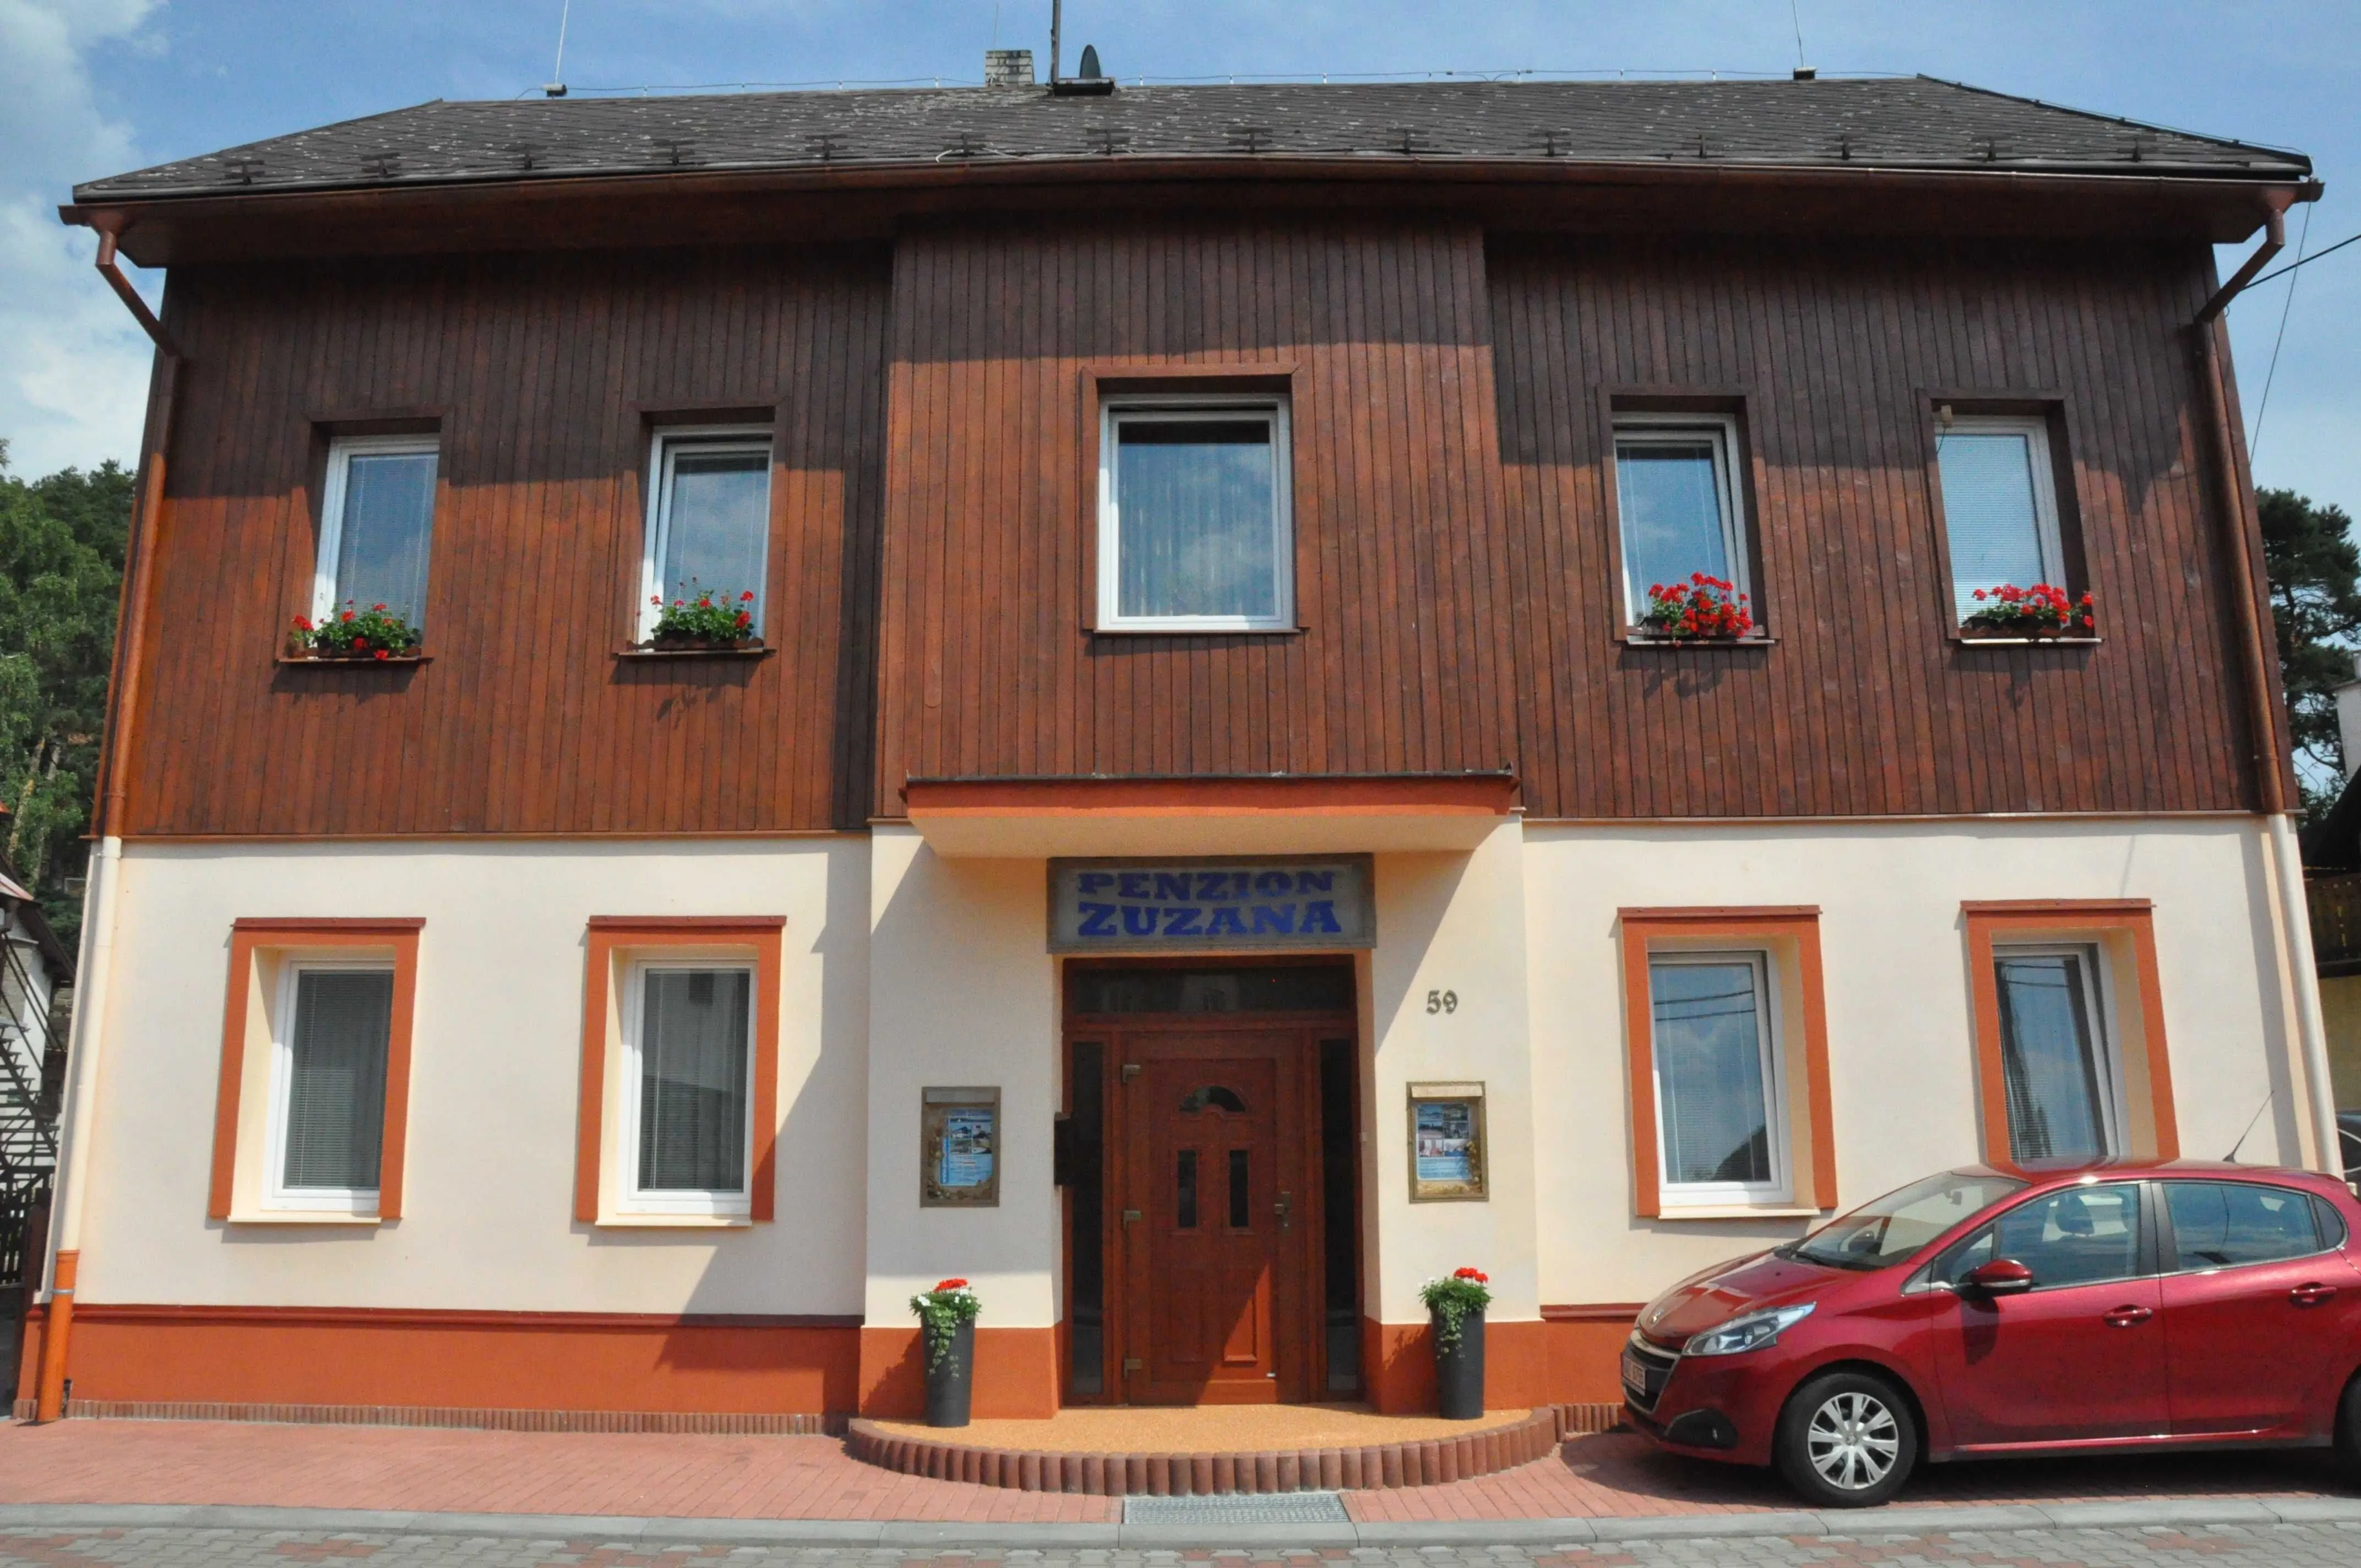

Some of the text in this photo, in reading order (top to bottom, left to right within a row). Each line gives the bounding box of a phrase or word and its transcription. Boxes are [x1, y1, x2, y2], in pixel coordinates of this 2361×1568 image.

[1078, 871, 1335, 900] PENZION
[1078, 900, 1341, 937] ZUZANA
[1426, 989, 1458, 1015] 59
